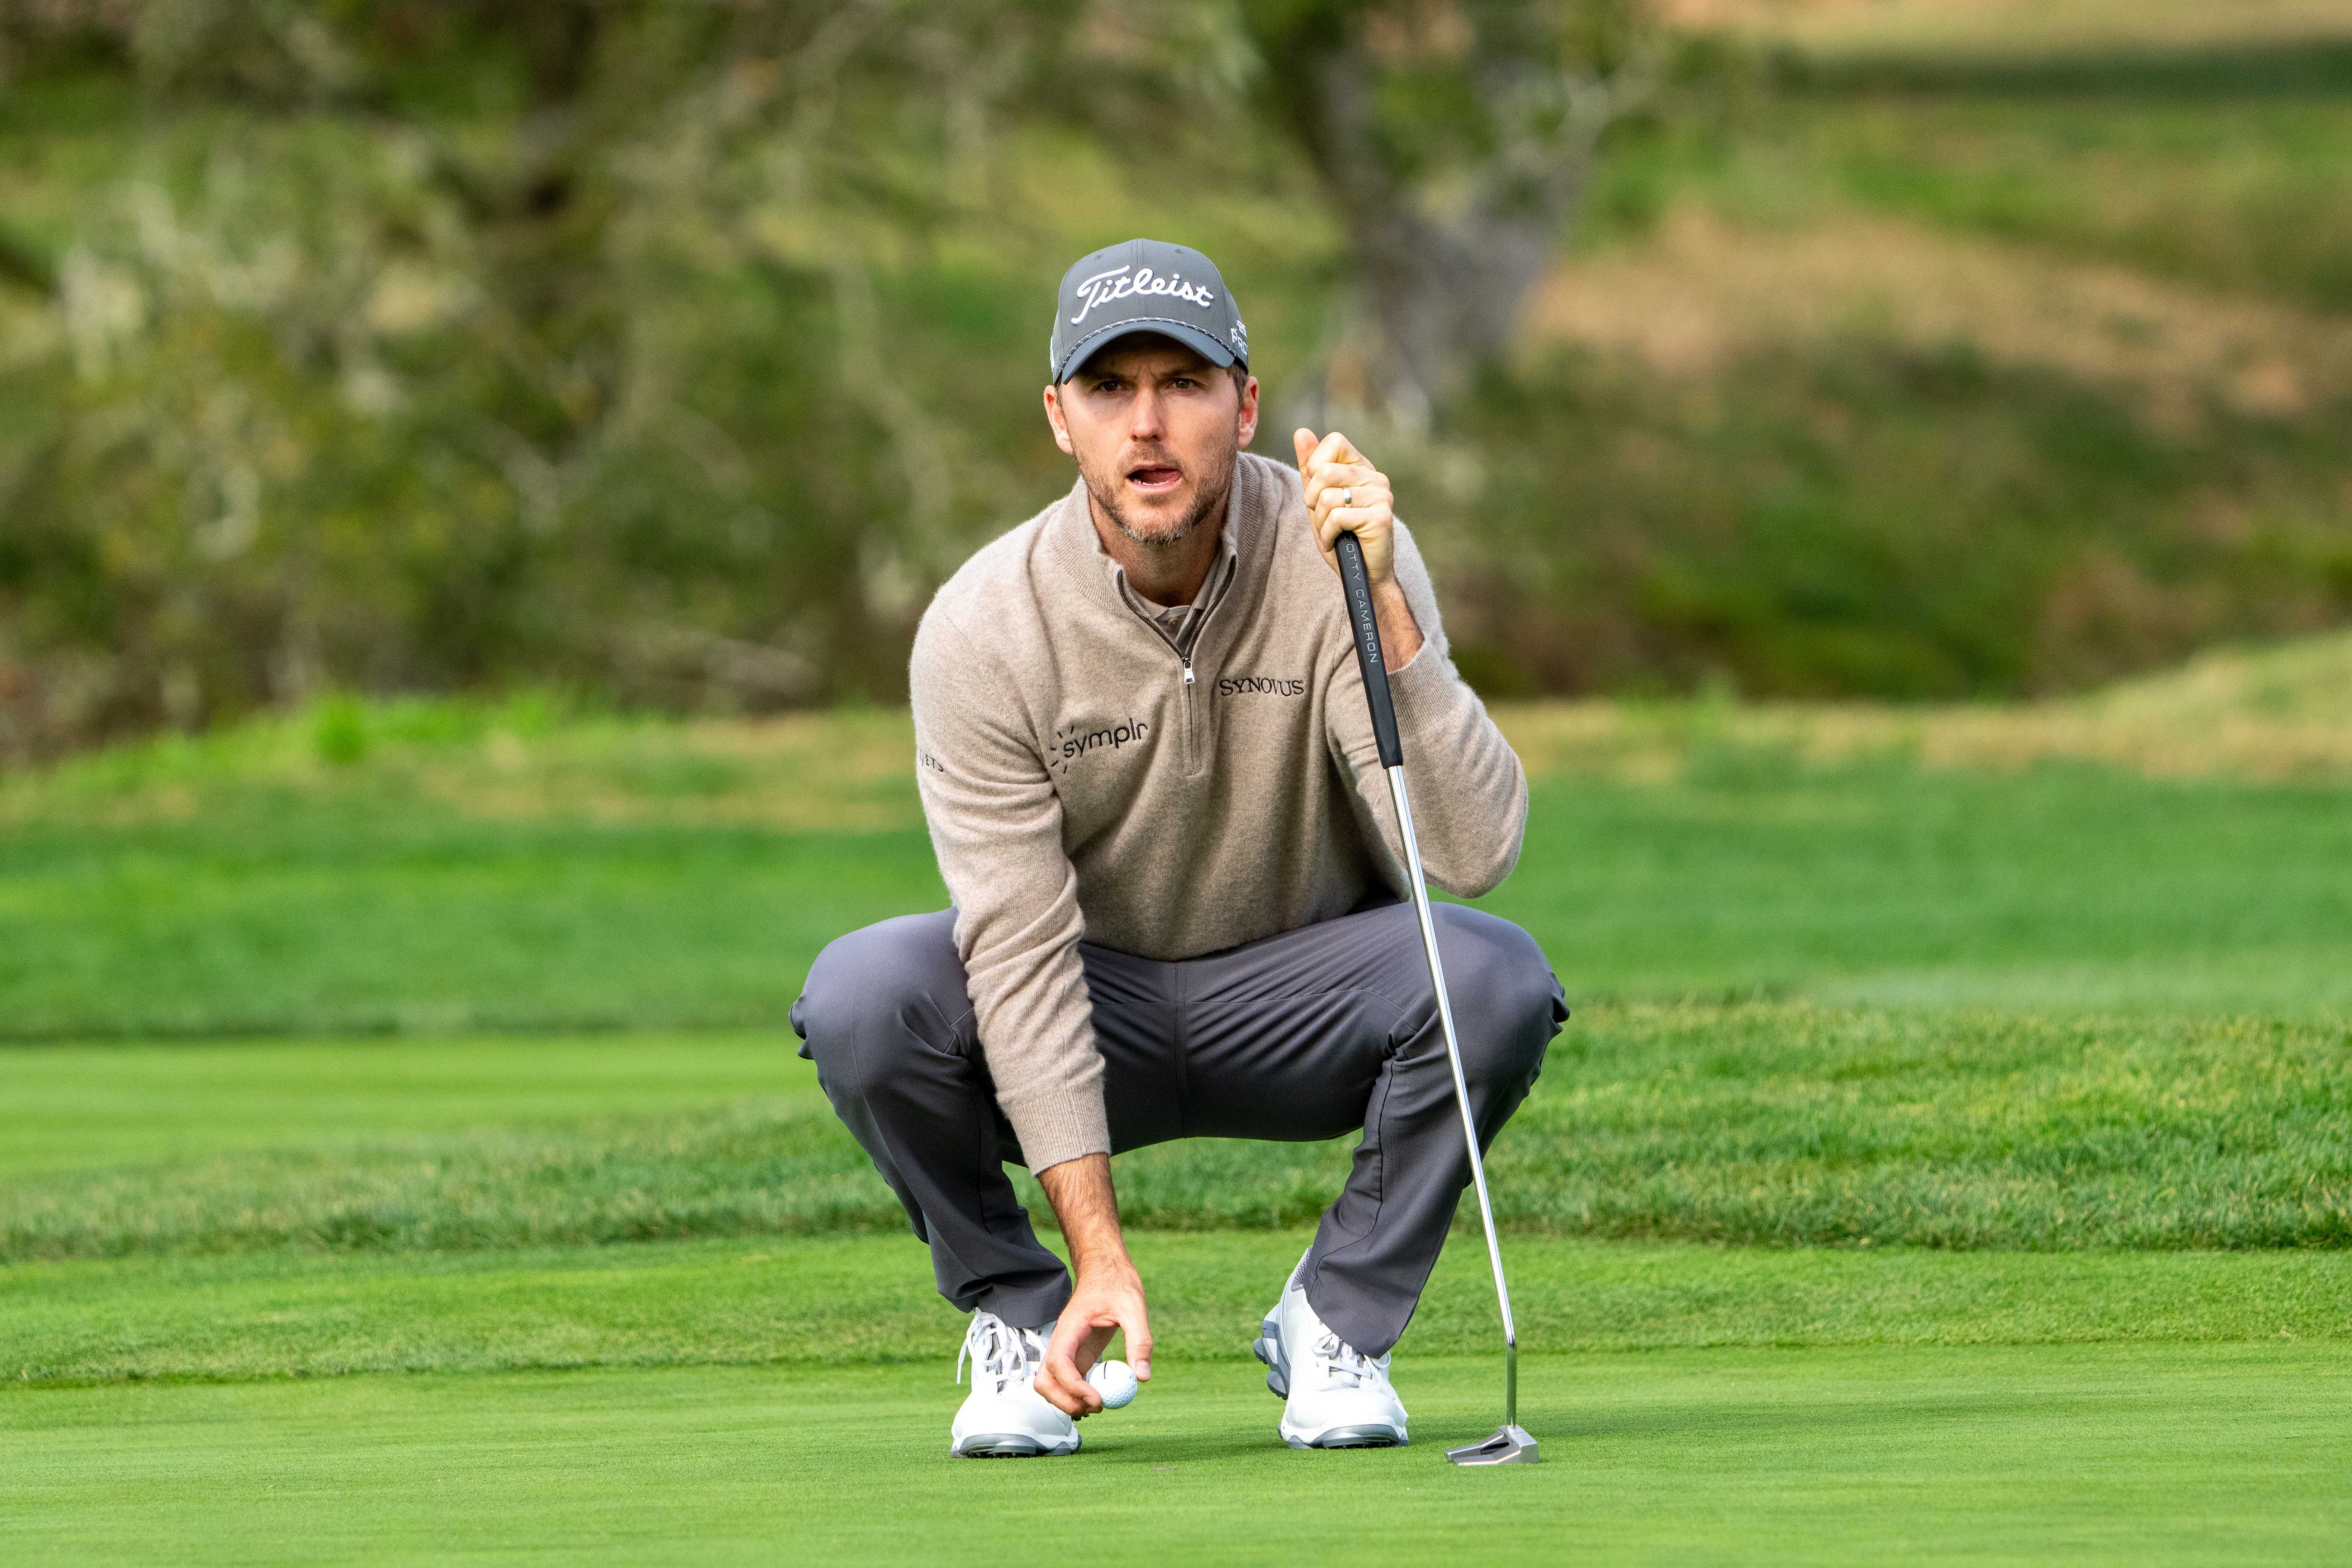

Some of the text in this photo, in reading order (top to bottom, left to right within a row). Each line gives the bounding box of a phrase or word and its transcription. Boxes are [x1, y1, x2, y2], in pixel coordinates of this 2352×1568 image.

[1071, 265, 1213, 325] Titleist
[1356, 588, 1378, 663] CAMERON
[1220, 677, 1304, 696] SYNOVUS
[1064, 718, 1148, 758] symplr
